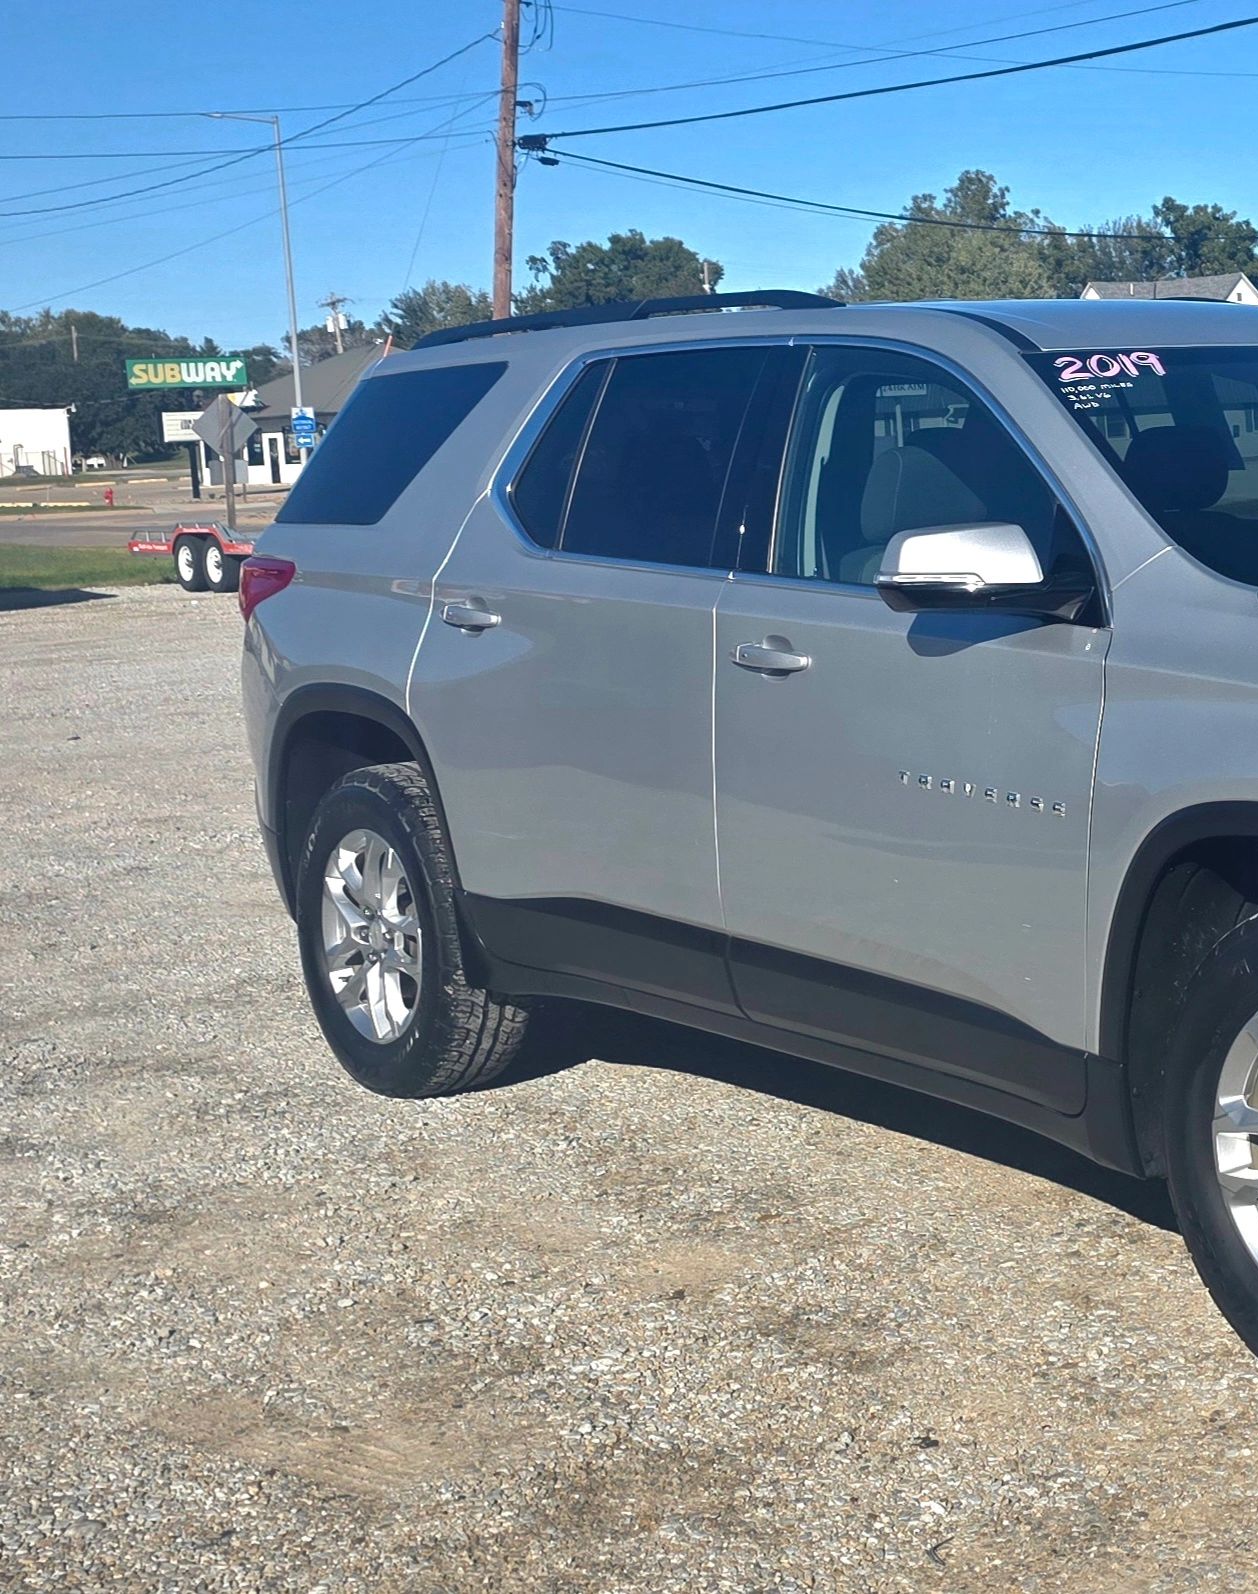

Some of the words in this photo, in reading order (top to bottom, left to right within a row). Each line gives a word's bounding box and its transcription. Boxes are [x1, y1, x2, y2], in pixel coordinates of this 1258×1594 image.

[129, 359, 243, 385] SUBWAY
[1053, 351, 1167, 382] 2019
[899, 769, 1066, 817] TRAVERSE
